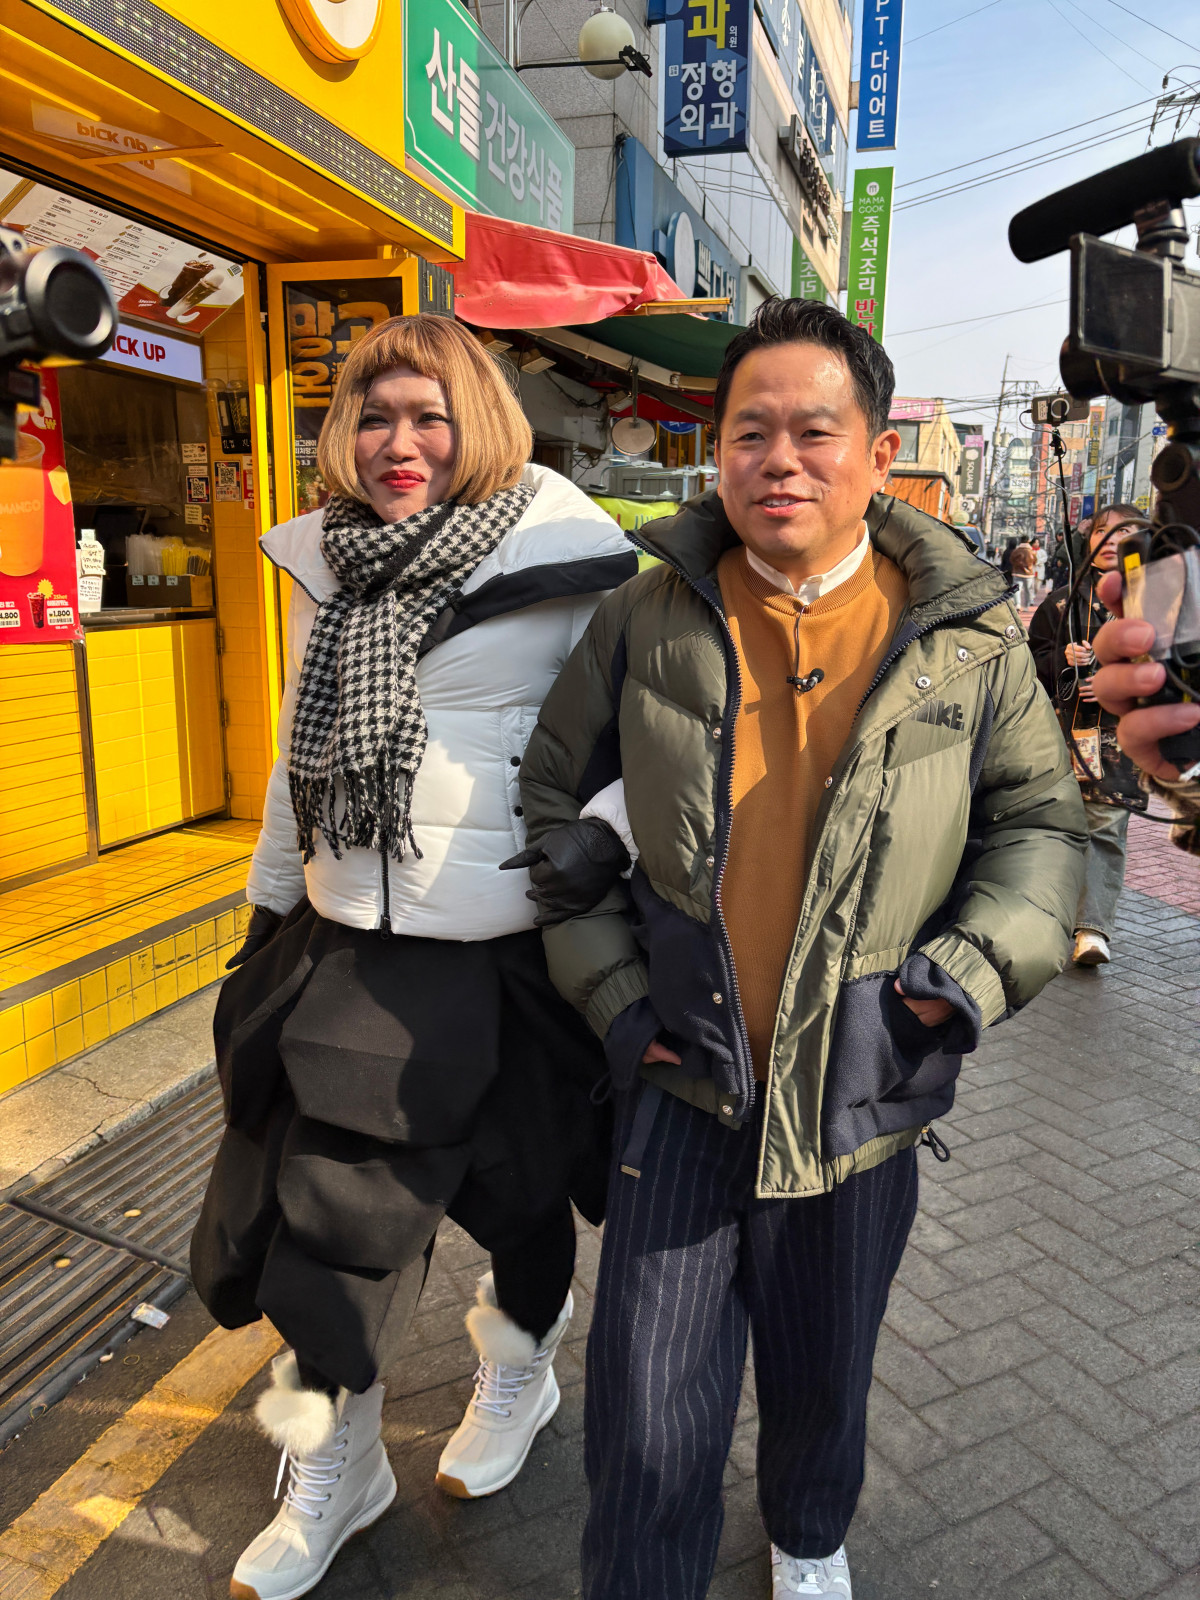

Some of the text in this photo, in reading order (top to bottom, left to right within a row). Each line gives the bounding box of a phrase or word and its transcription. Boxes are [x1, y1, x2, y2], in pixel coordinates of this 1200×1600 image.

[729, 25, 738, 48] 의원
[680, 59, 737, 100] 정형
[425, 27, 482, 161] 산들
[484, 90, 562, 231] 건강식품
[679, 102, 739, 140] 외과
[858, 205, 884, 214] COOK
[859, 215, 881, 296] 즉석조리
[111, 335, 166, 362] ICK UP
[966, 461, 974, 490] SQUARE
